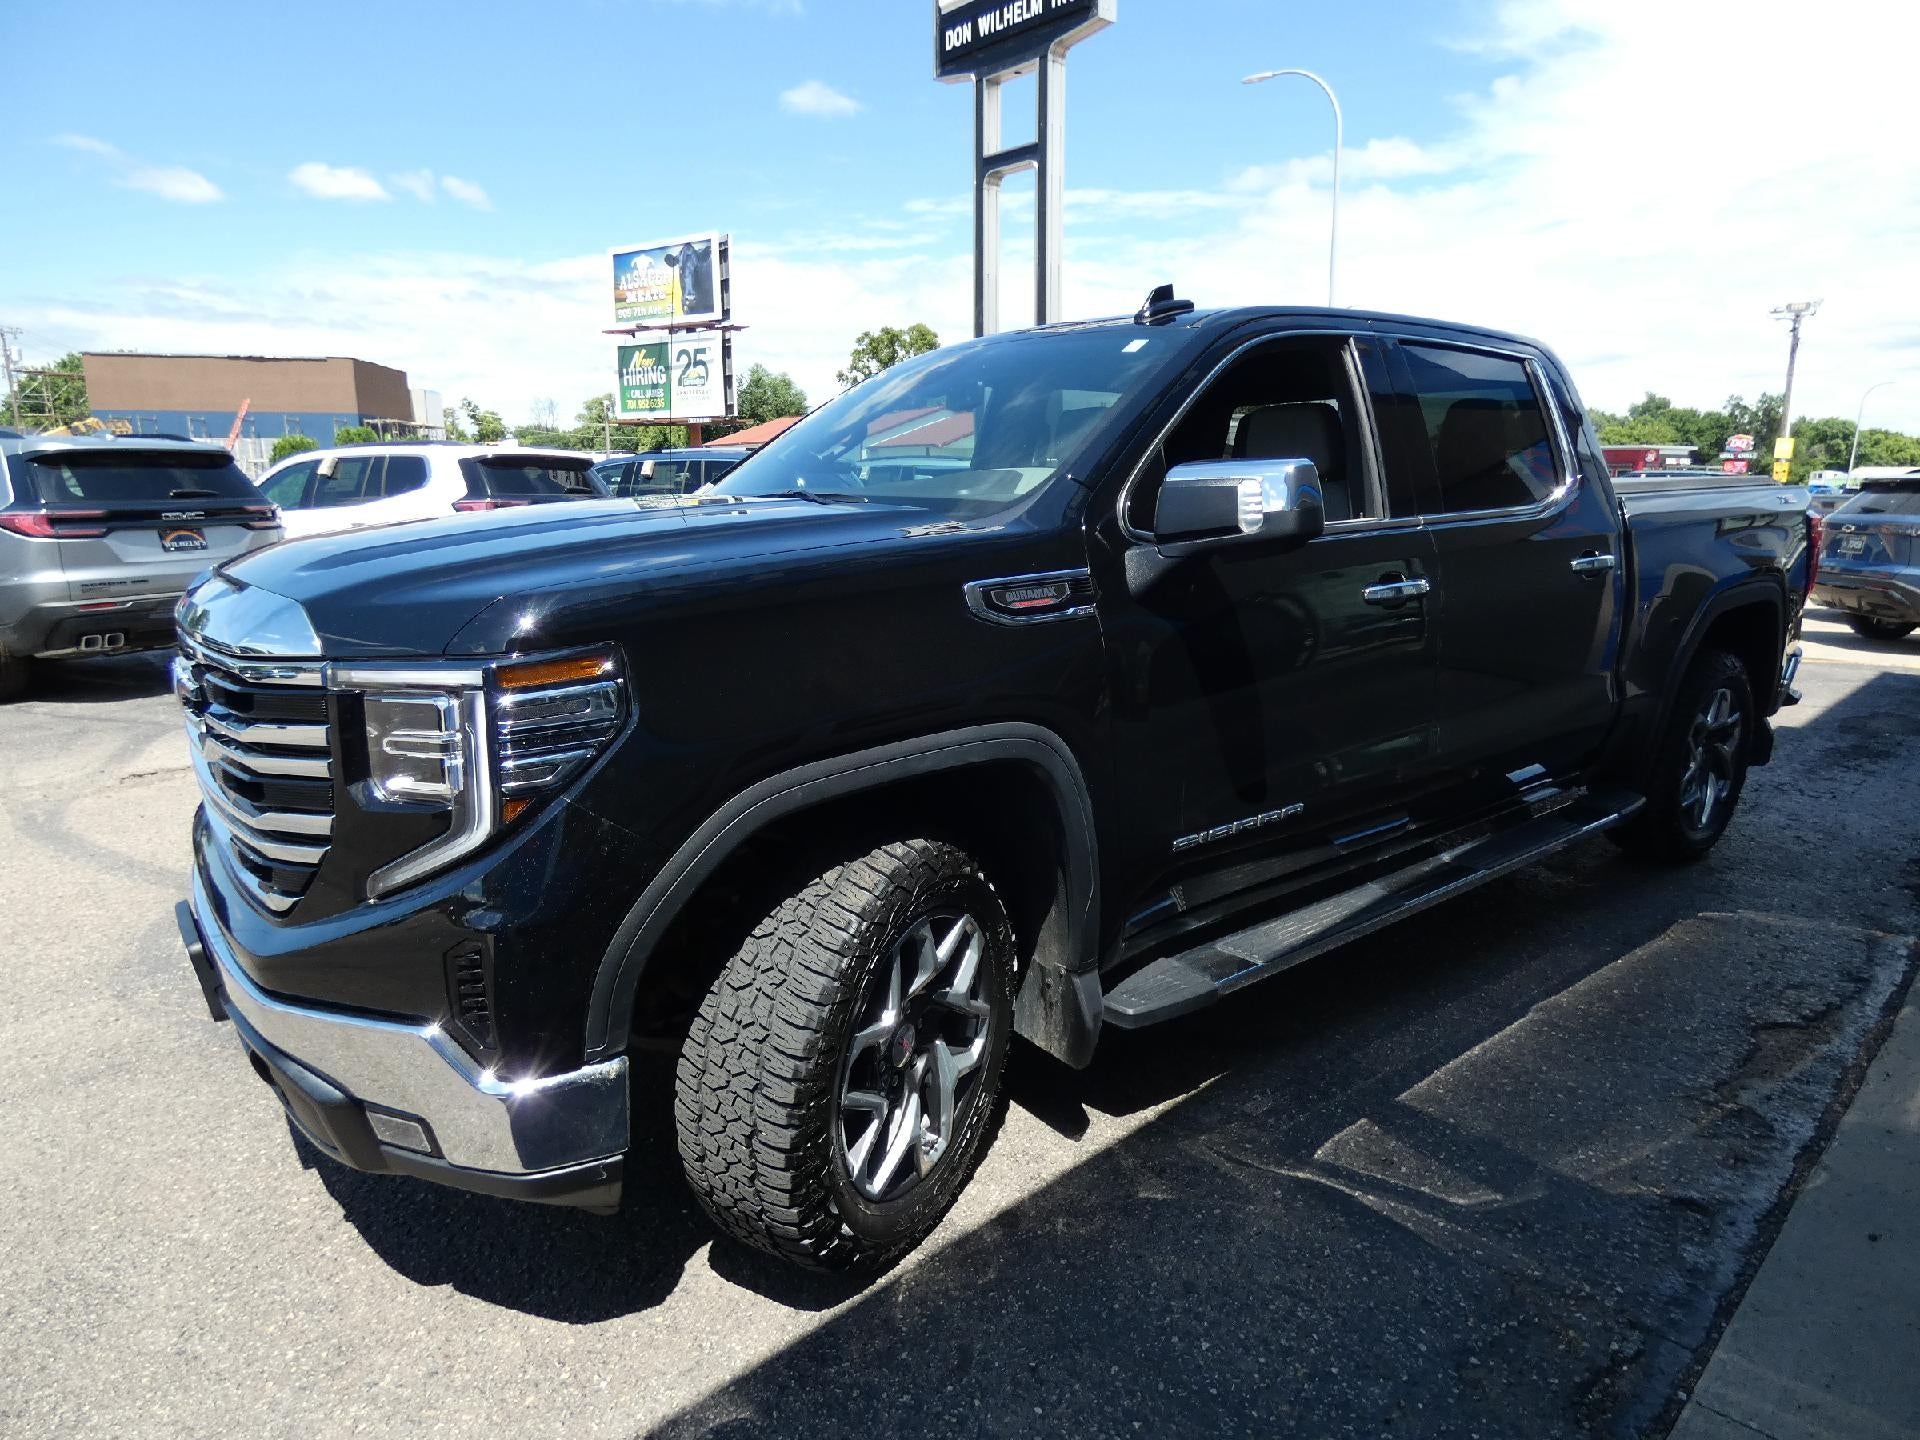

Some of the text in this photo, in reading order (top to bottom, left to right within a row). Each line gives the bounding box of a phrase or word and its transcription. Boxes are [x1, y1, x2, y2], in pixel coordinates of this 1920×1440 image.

[945, 0, 1043, 51] DON WILHELM
[629, 348, 656, 369] Now
[676, 347, 709, 387] 25
[623, 366, 666, 387] HIRING
[161, 511, 206, 521] GMC
[1005, 585, 1057, 602] DURAMAX
[1172, 801, 1304, 852] SIERRA
